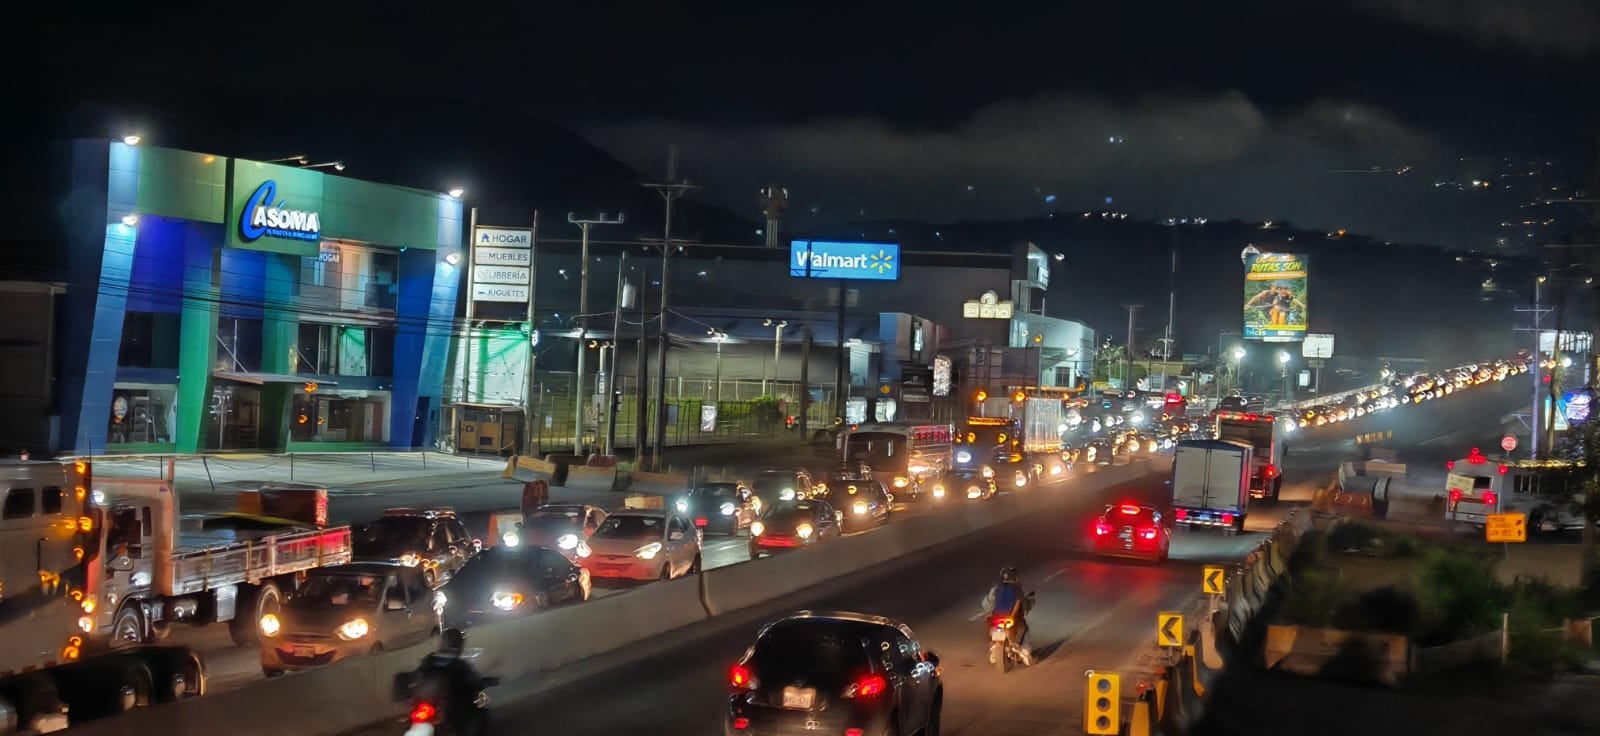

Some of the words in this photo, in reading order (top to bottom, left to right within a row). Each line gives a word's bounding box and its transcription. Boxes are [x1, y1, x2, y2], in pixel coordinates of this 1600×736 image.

[492, 234, 527, 244] HOGAR
[488, 252, 528, 262] MUEBLES
[796, 251, 867, 269] Walmart
[1252, 263, 1279, 272] RUTAS
[489, 271, 527, 280] LIBRERÍA
[486, 288, 525, 297] JUGUETES
